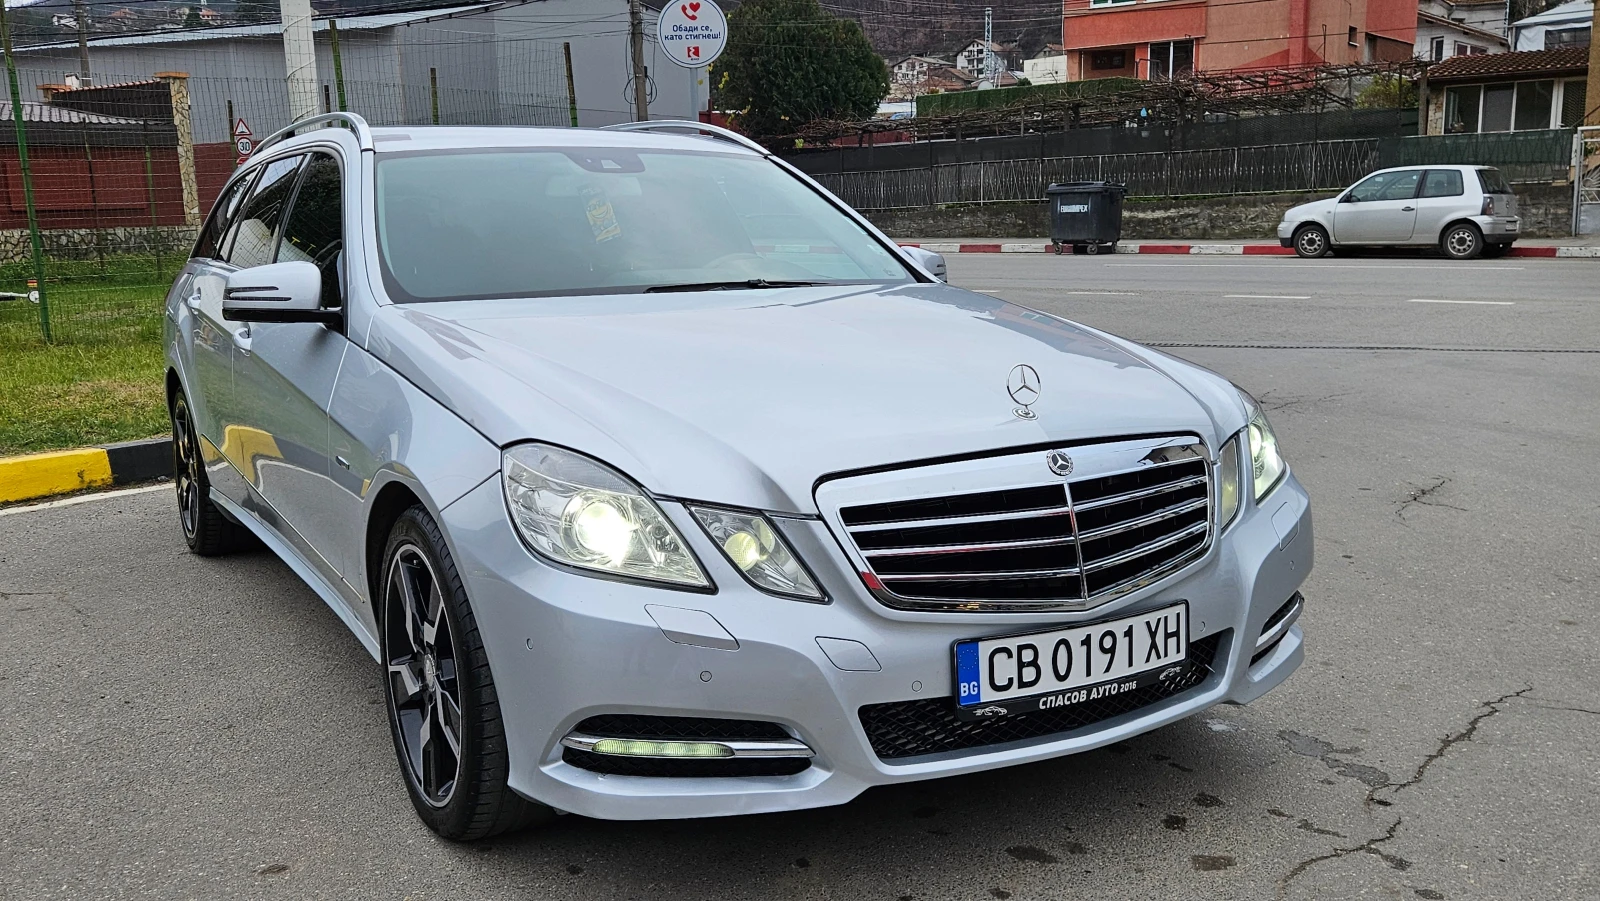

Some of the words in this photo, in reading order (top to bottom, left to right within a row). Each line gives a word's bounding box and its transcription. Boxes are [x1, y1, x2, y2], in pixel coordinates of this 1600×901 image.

[673, 24, 698, 33] Обади
[685, 32, 721, 40] стигнеш!
[240, 142, 250, 152] 30
[988, 643, 1042, 693] CB
[1052, 624, 1134, 683] 0191
[1144, 611, 1181, 664] XH
[960, 682, 978, 697] BG
[1038, 690, 1087, 710] СПАСОВ
[1090, 684, 1118, 700] АУТО
[1120, 680, 1137, 694] 2016
